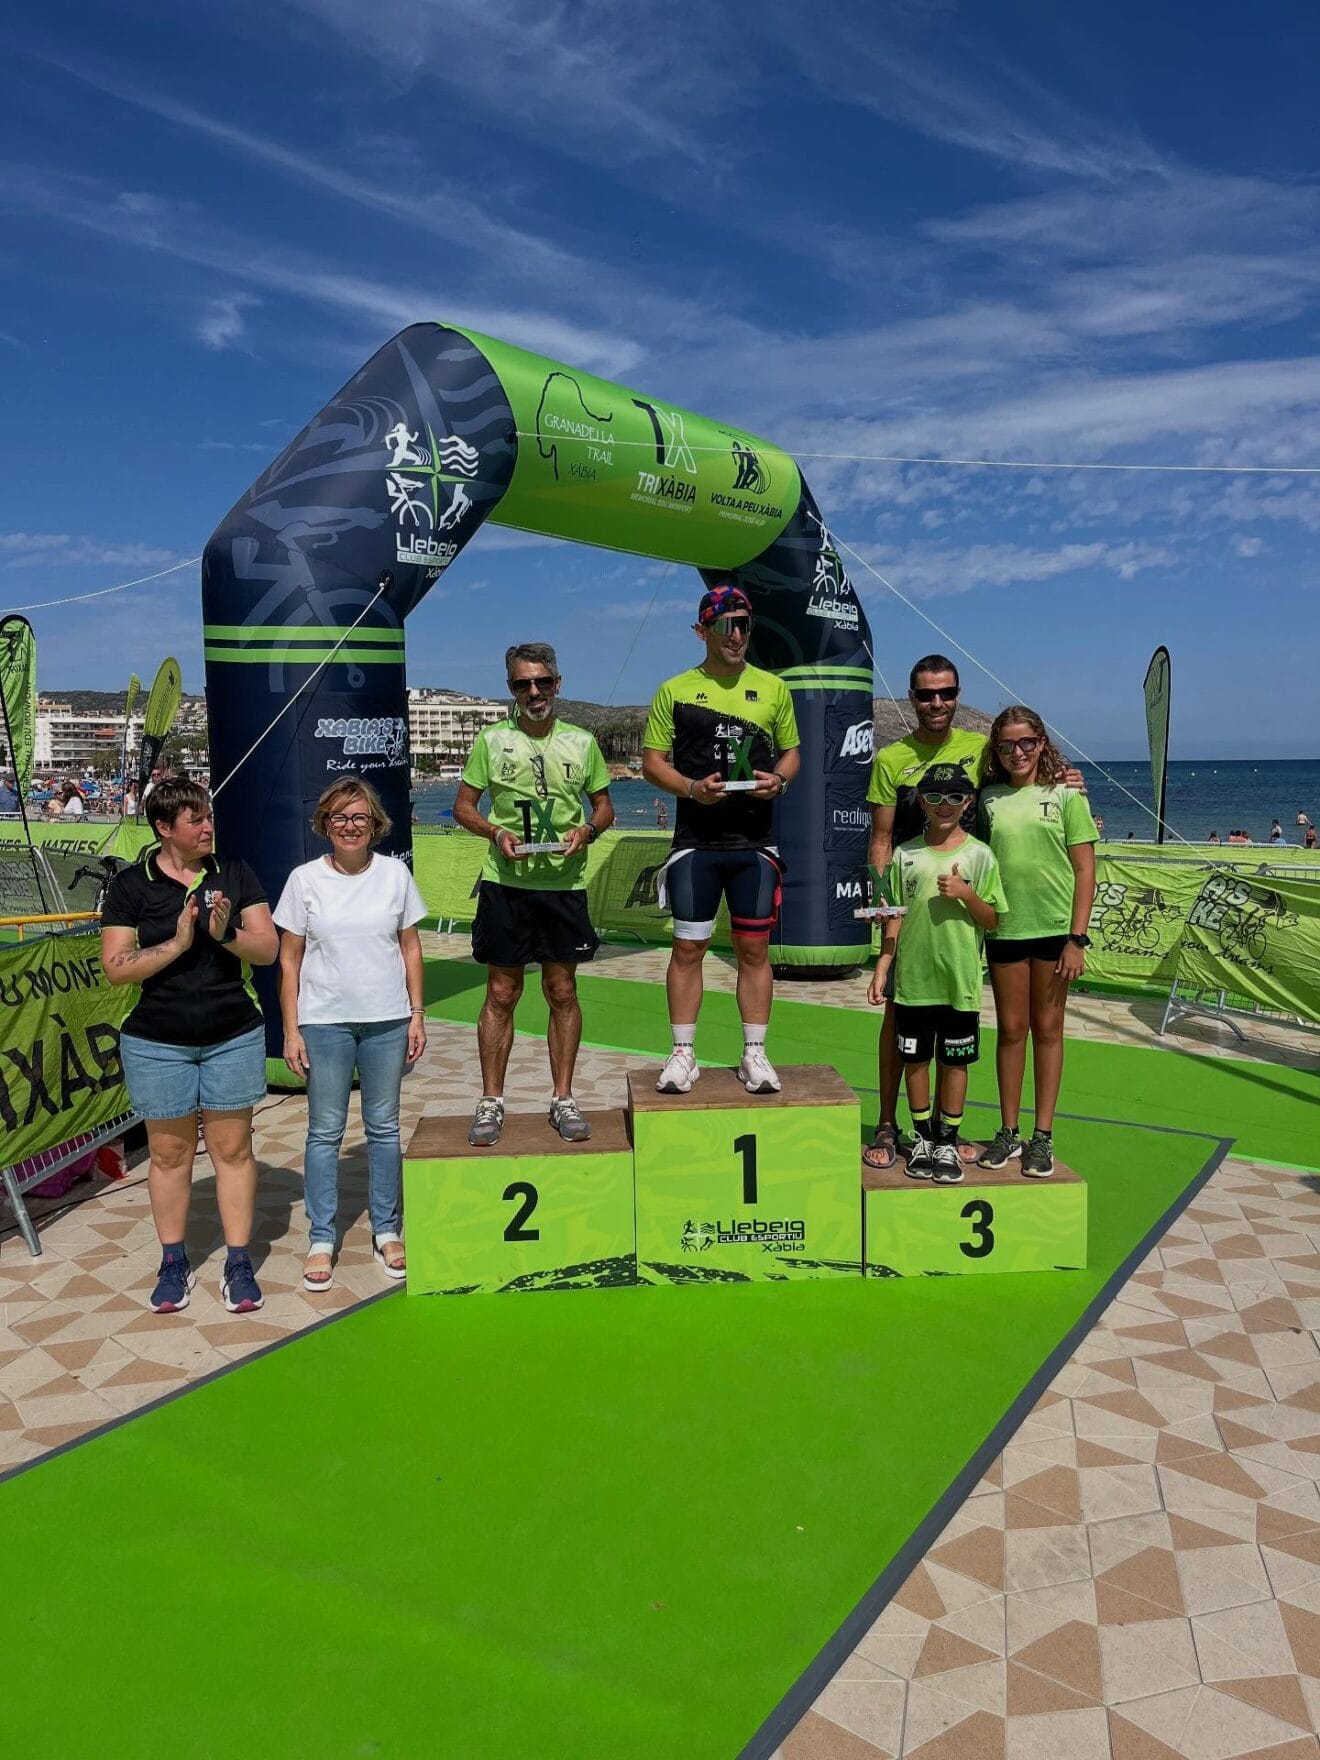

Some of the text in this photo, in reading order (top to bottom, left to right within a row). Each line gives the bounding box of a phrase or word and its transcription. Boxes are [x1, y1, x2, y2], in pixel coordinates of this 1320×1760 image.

[543, 413, 615, 447] GRANADELLA
[586, 445, 614, 466] TRAIL
[636, 471, 697, 505] TRIXÀBIA
[710, 492, 736, 508] VOLTA
[735, 499, 742, 509] A
[742, 501, 759, 513] PEU
[809, 595, 858, 616] Llebeig
[833, 619, 859, 631] Xàbia
[24, 727, 32, 746] EDU
[314, 718, 394, 737] XABIA'S
[343, 736, 387, 754] BIKE
[326, 759, 356, 771] Ride
[360, 761, 386, 774] your
[1102, 939, 1170, 960] dreams
[733, 1133, 758, 1205] 1
[502, 1181, 540, 1242] 2
[716, 1219, 805, 1236] Llebeig
[719, 1232, 803, 1243] CLUB ESPORTIU
[959, 1199, 995, 1259] 3
[761, 1241, 806, 1253] Xàbia
